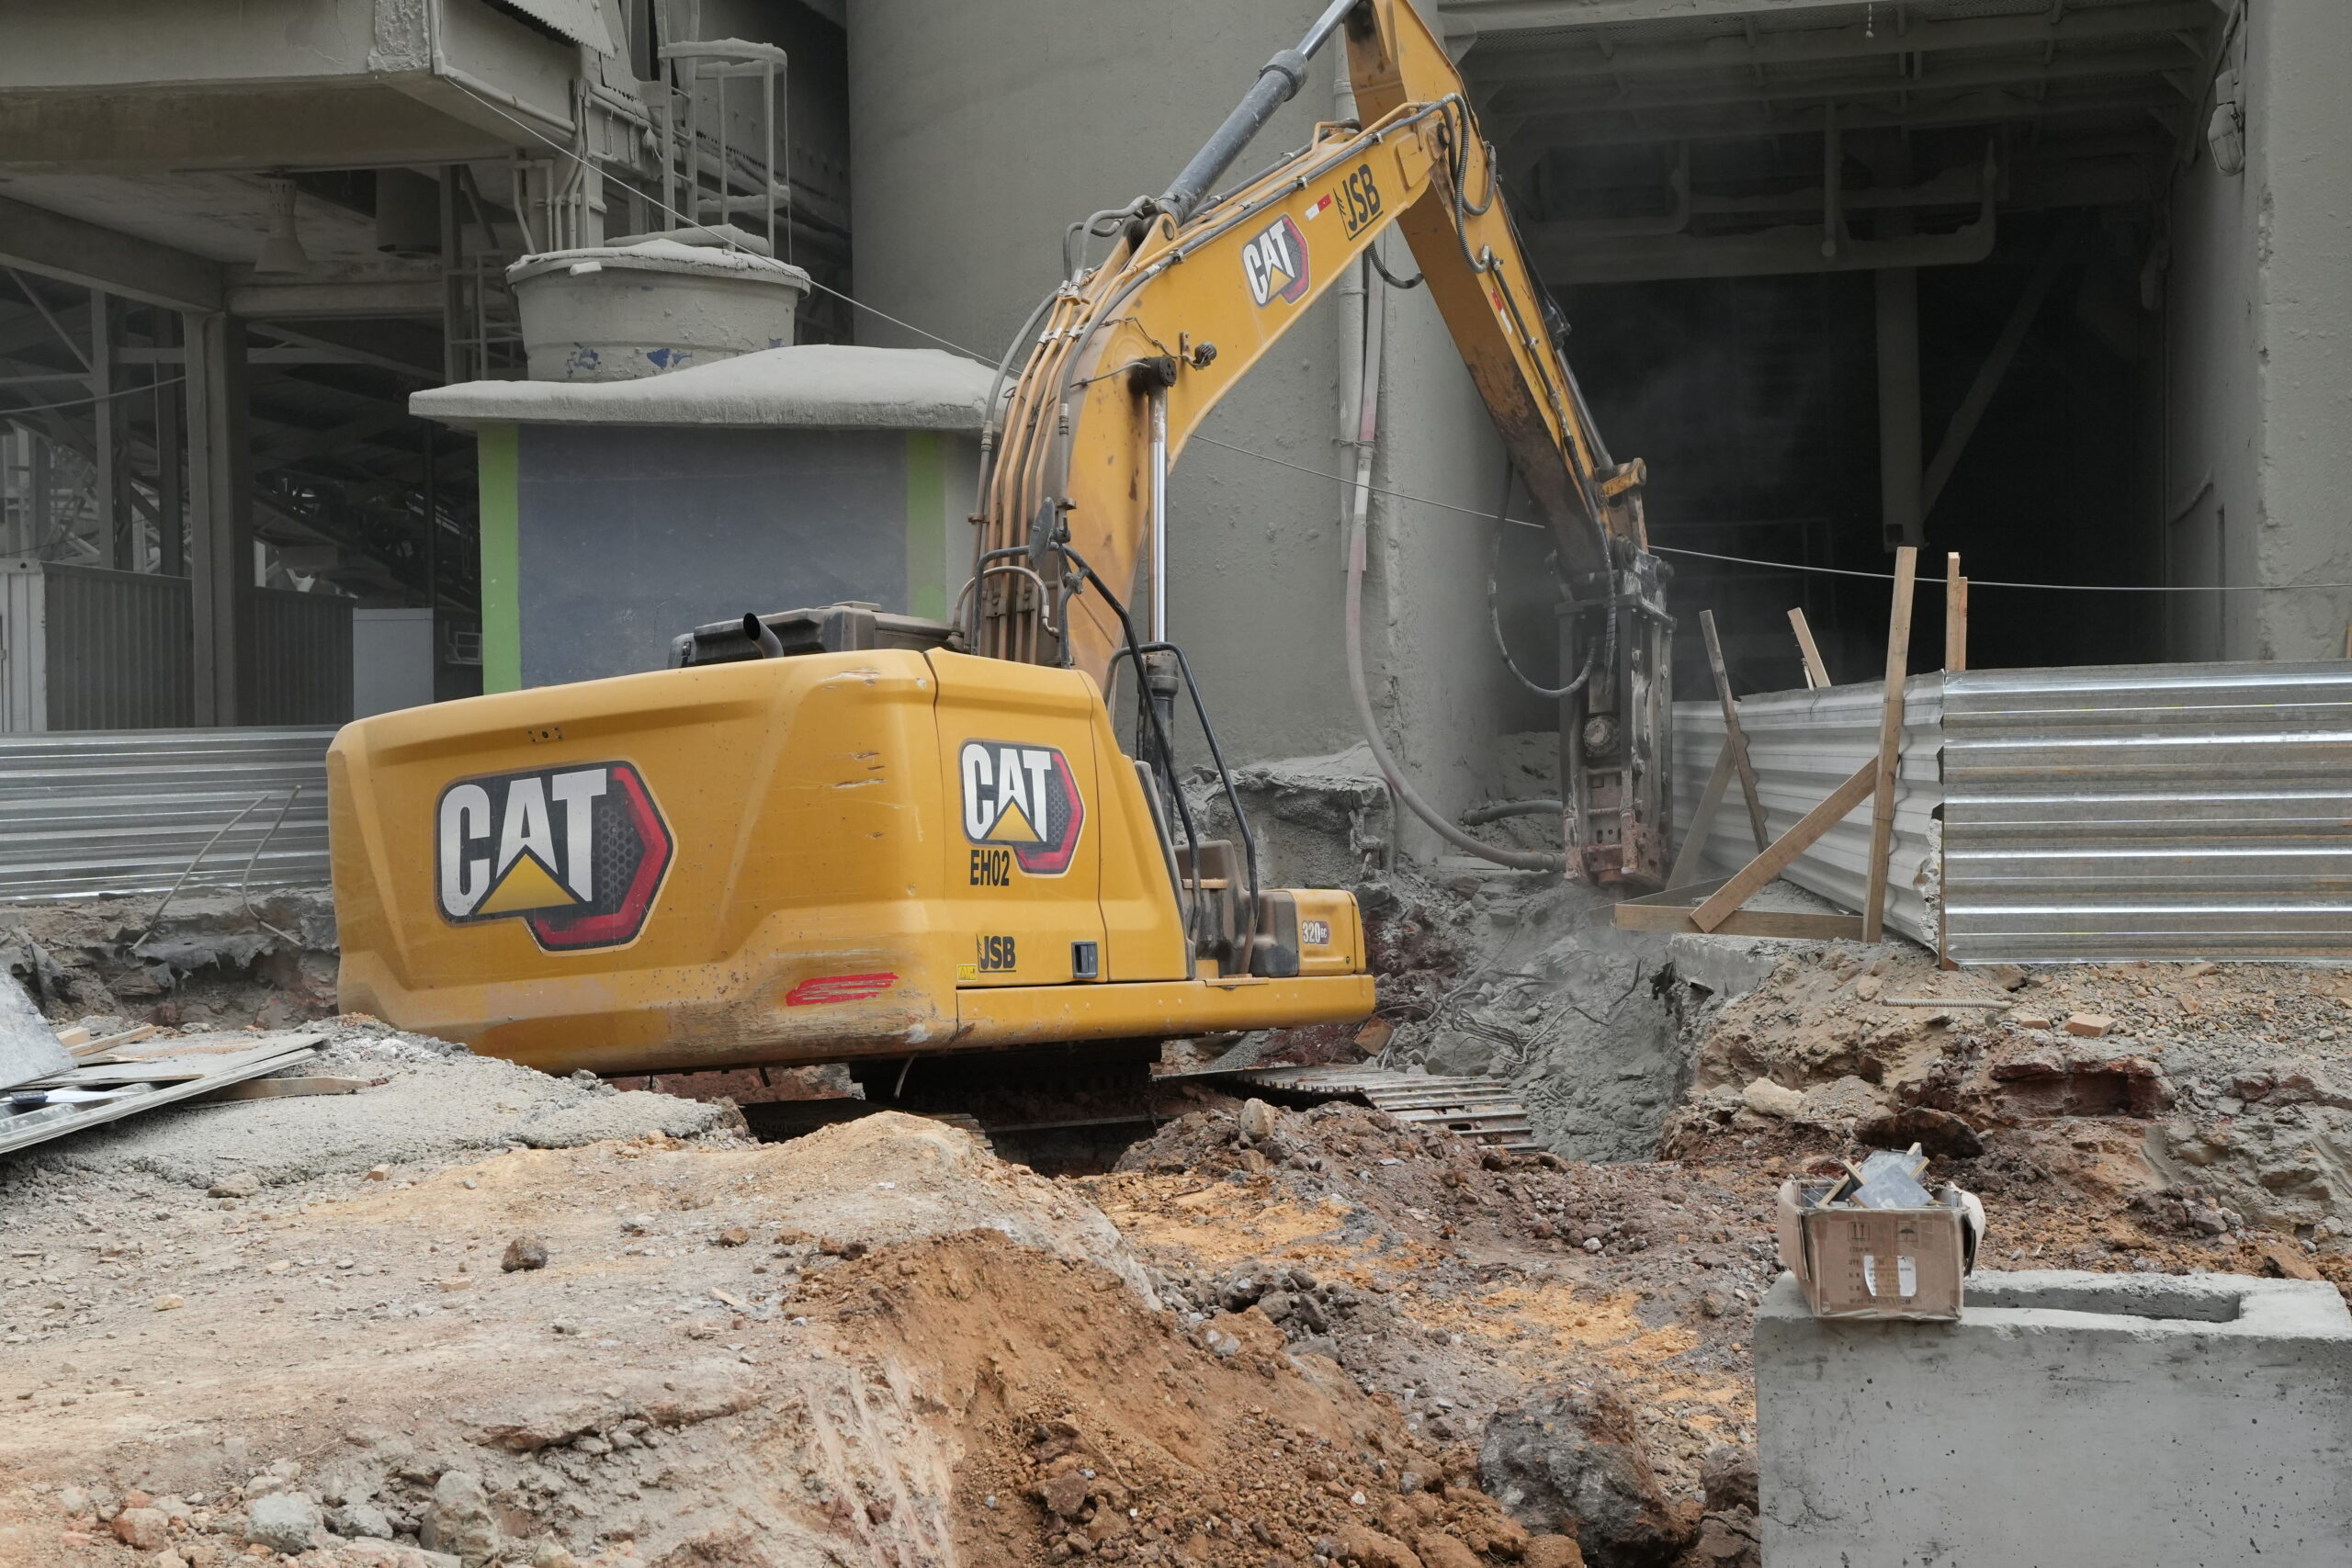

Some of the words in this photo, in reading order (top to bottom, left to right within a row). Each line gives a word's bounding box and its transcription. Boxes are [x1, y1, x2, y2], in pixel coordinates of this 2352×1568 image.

[1342, 164, 1381, 231] JSB
[1243, 220, 1295, 304] CAT
[962, 743, 1052, 842] CAT
[440, 768, 607, 917] CAT
[969, 850, 1011, 886] EH02
[979, 935, 1016, 970] JSB
[1302, 921, 1321, 943] 320
